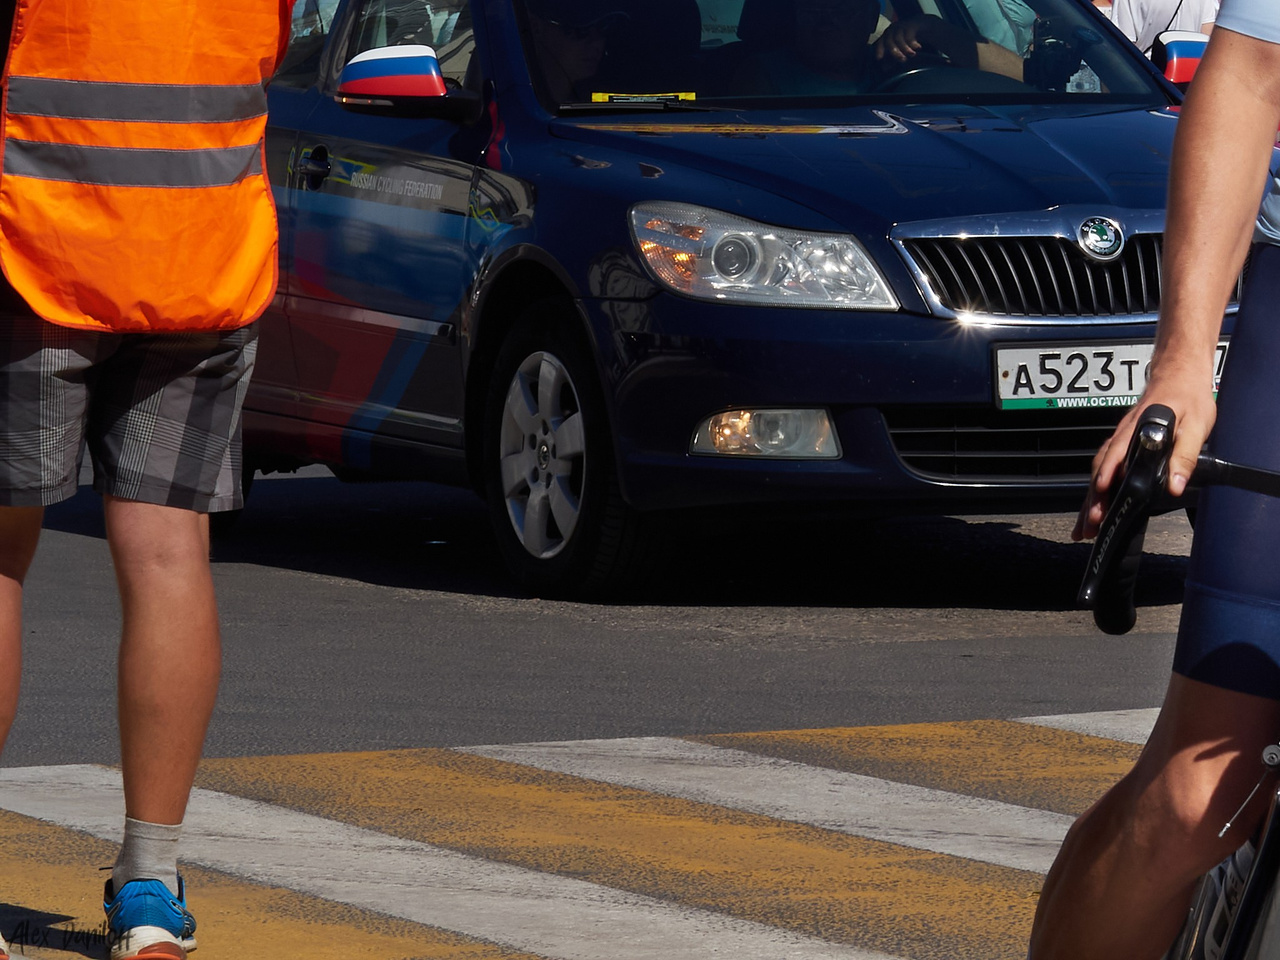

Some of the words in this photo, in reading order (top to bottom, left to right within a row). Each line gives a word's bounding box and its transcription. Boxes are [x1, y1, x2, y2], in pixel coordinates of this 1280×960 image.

[350, 171, 378, 190] RUSSIAN
[377, 176, 405, 195] CYCLING
[404, 180, 444, 200] FEDERATION
